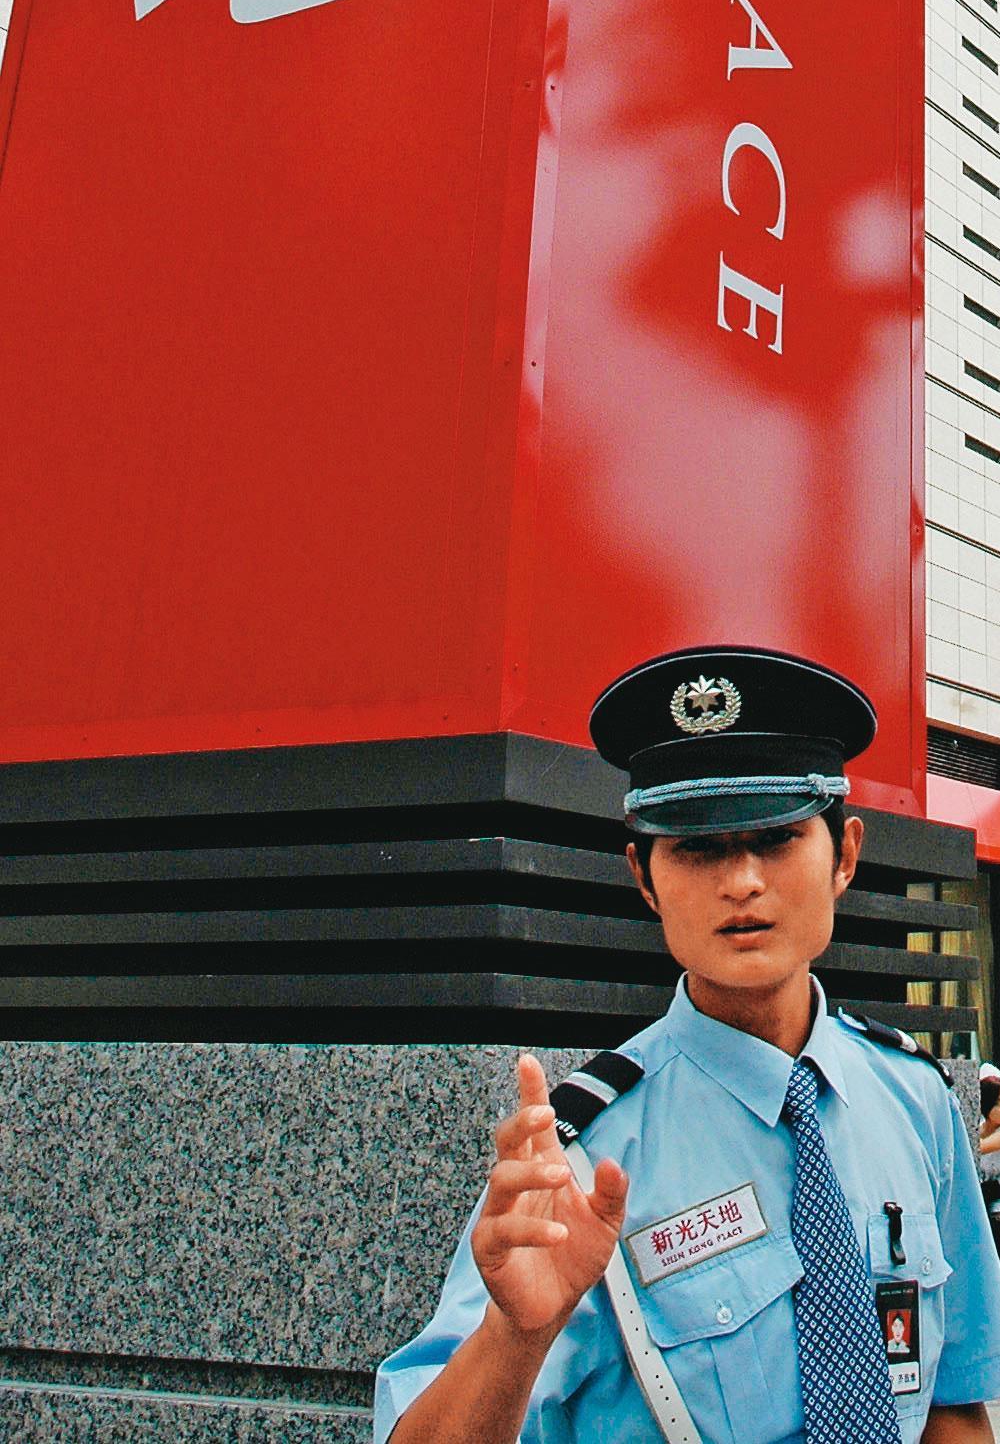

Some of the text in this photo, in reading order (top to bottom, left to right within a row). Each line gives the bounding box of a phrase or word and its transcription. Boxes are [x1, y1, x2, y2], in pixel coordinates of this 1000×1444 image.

[650, 1200, 743, 1255] 新光天地
[661, 1226, 743, 1267] SHIN KONG PLACE
